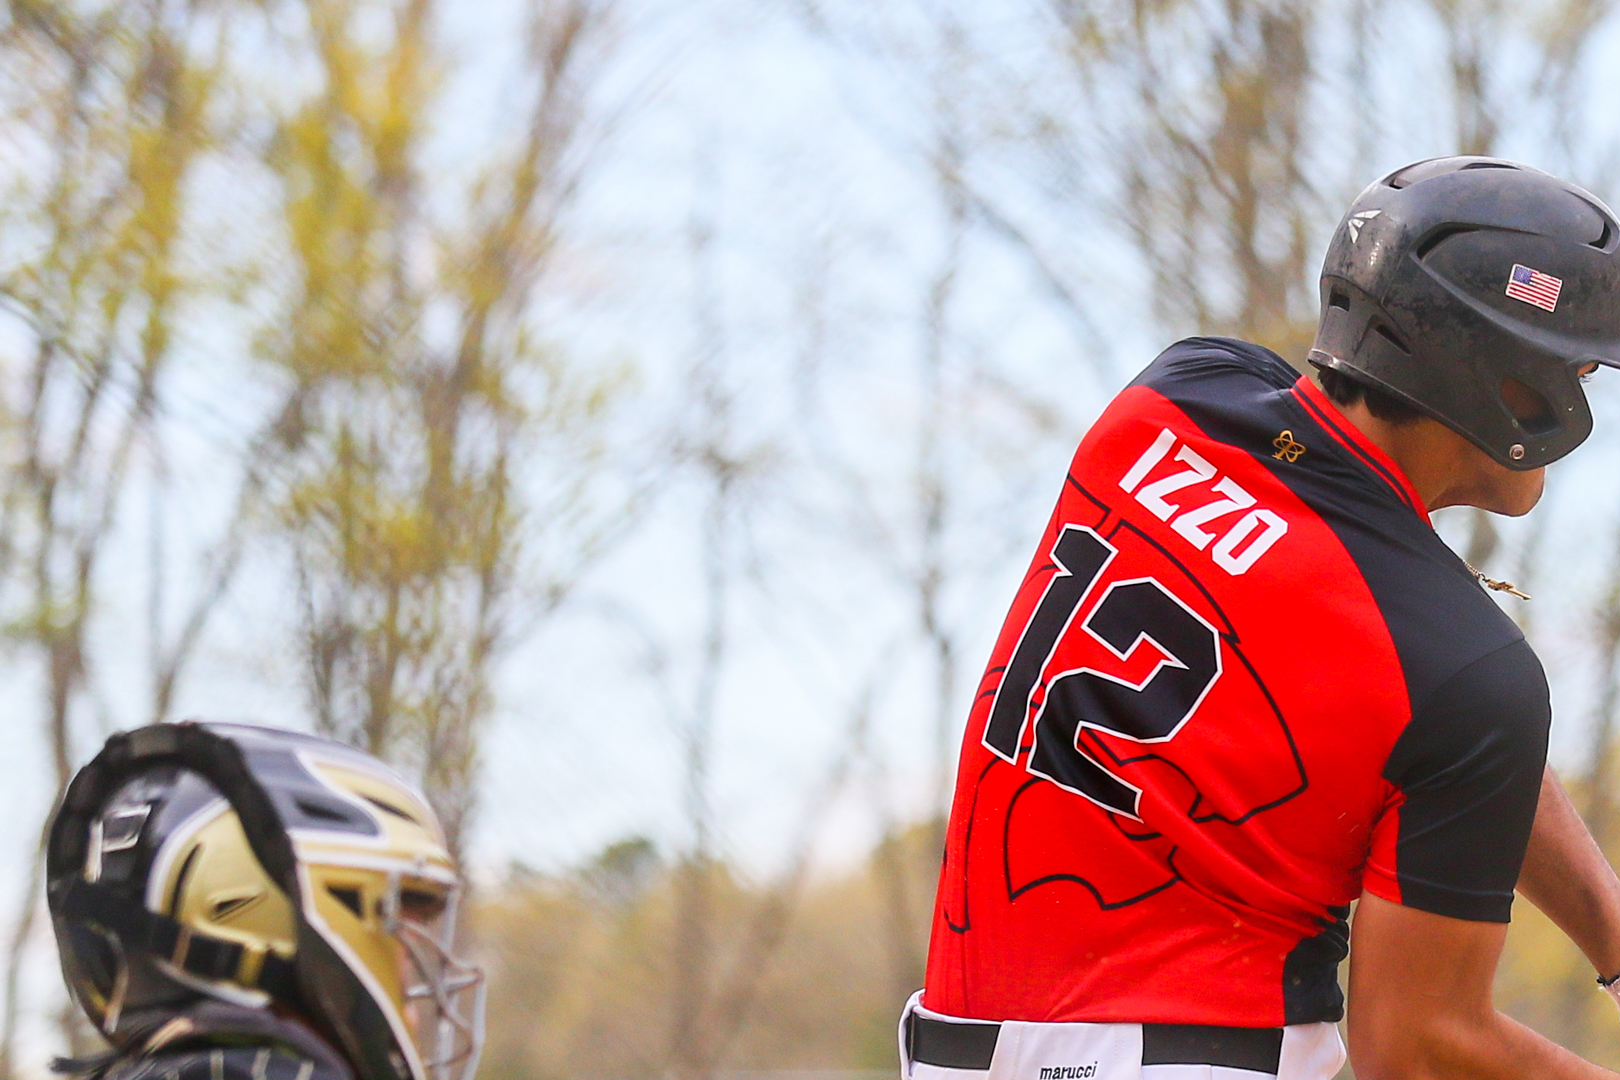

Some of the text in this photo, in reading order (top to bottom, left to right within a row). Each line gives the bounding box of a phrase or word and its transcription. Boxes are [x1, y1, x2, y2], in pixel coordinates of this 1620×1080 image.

[1118, 427, 1289, 576] IZZO
[982, 522, 1223, 823] 12
[1039, 1061, 1098, 1080] marucci
